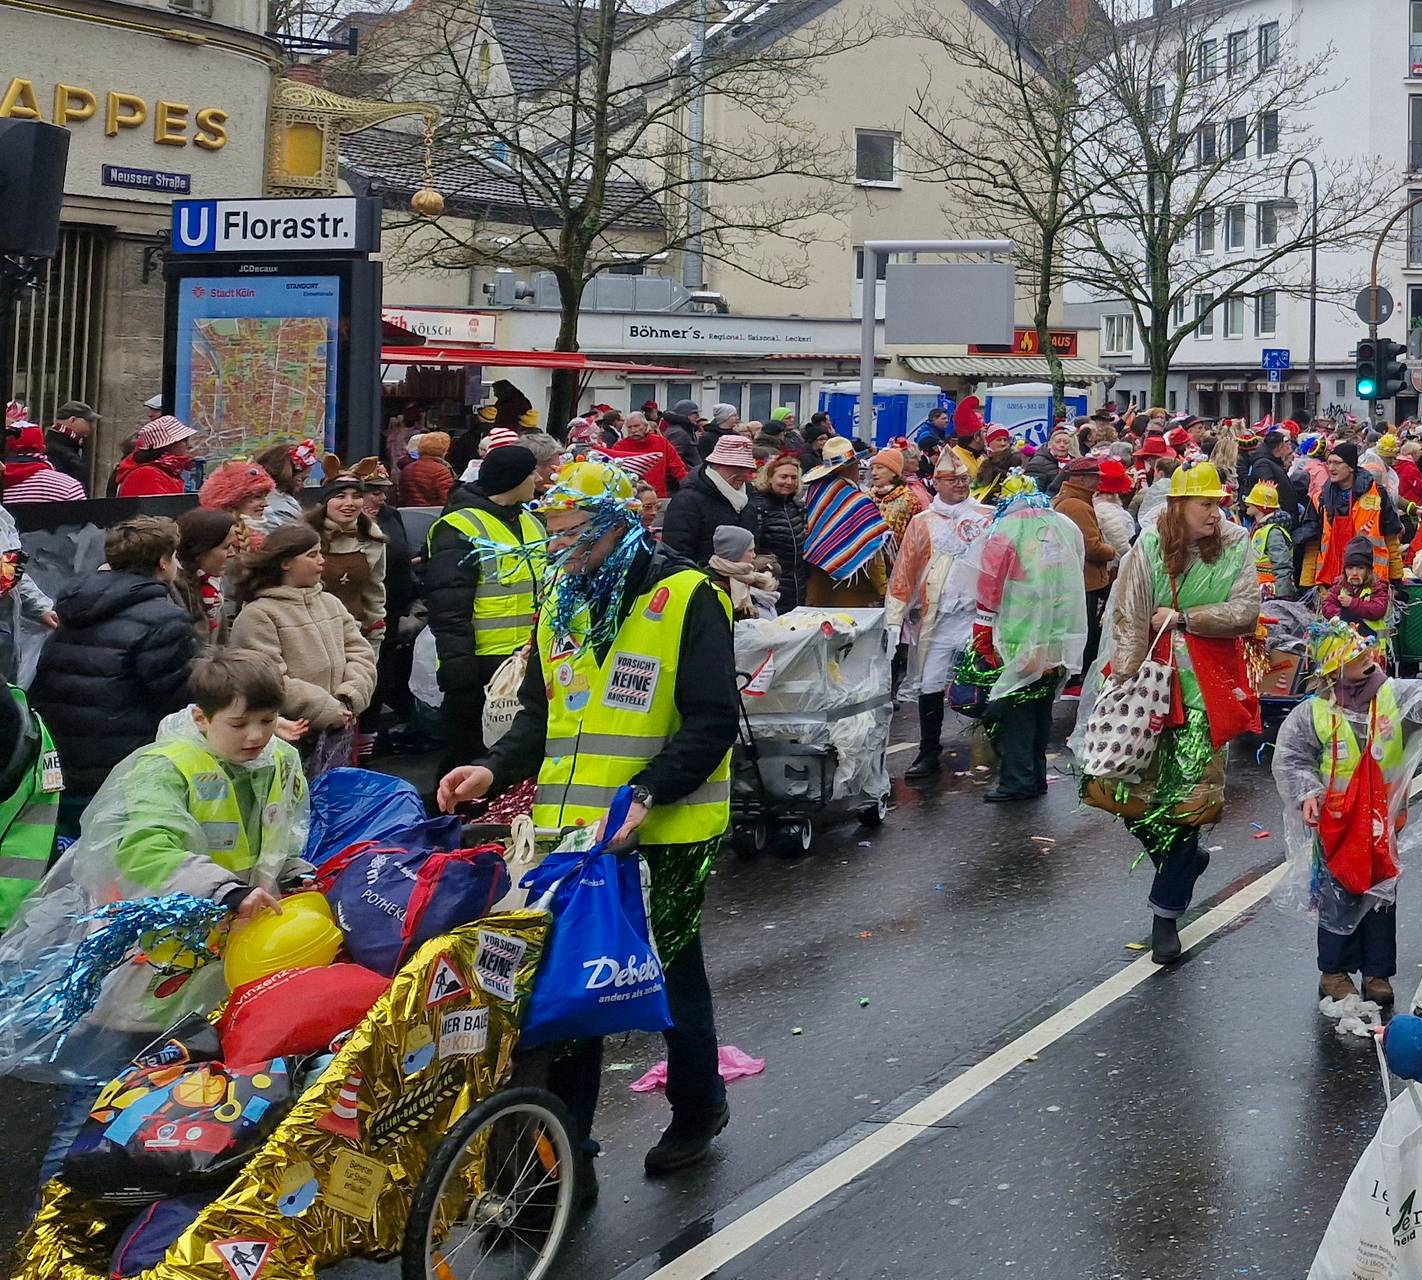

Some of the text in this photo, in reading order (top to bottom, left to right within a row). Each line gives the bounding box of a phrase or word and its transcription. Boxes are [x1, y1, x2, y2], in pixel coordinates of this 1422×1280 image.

[110, 168, 186, 190] Neusser Straße
[180, 207, 349, 247] U Florastr.
[238, 264, 279, 273] JCDecaux
[210, 286, 255, 298] Stadt Köln
[411, 322, 452, 336] KÖLSCH
[616, 655, 657, 670] VORSICHT
[611, 670, 653, 692] KEINE
[607, 692, 647, 707] BAUSTELLE
[483, 934, 522, 956] VORSICHT
[478, 948, 515, 980] KEINE
[598, 991, 631, 1003] anders
[631, 988, 644, 999] als
